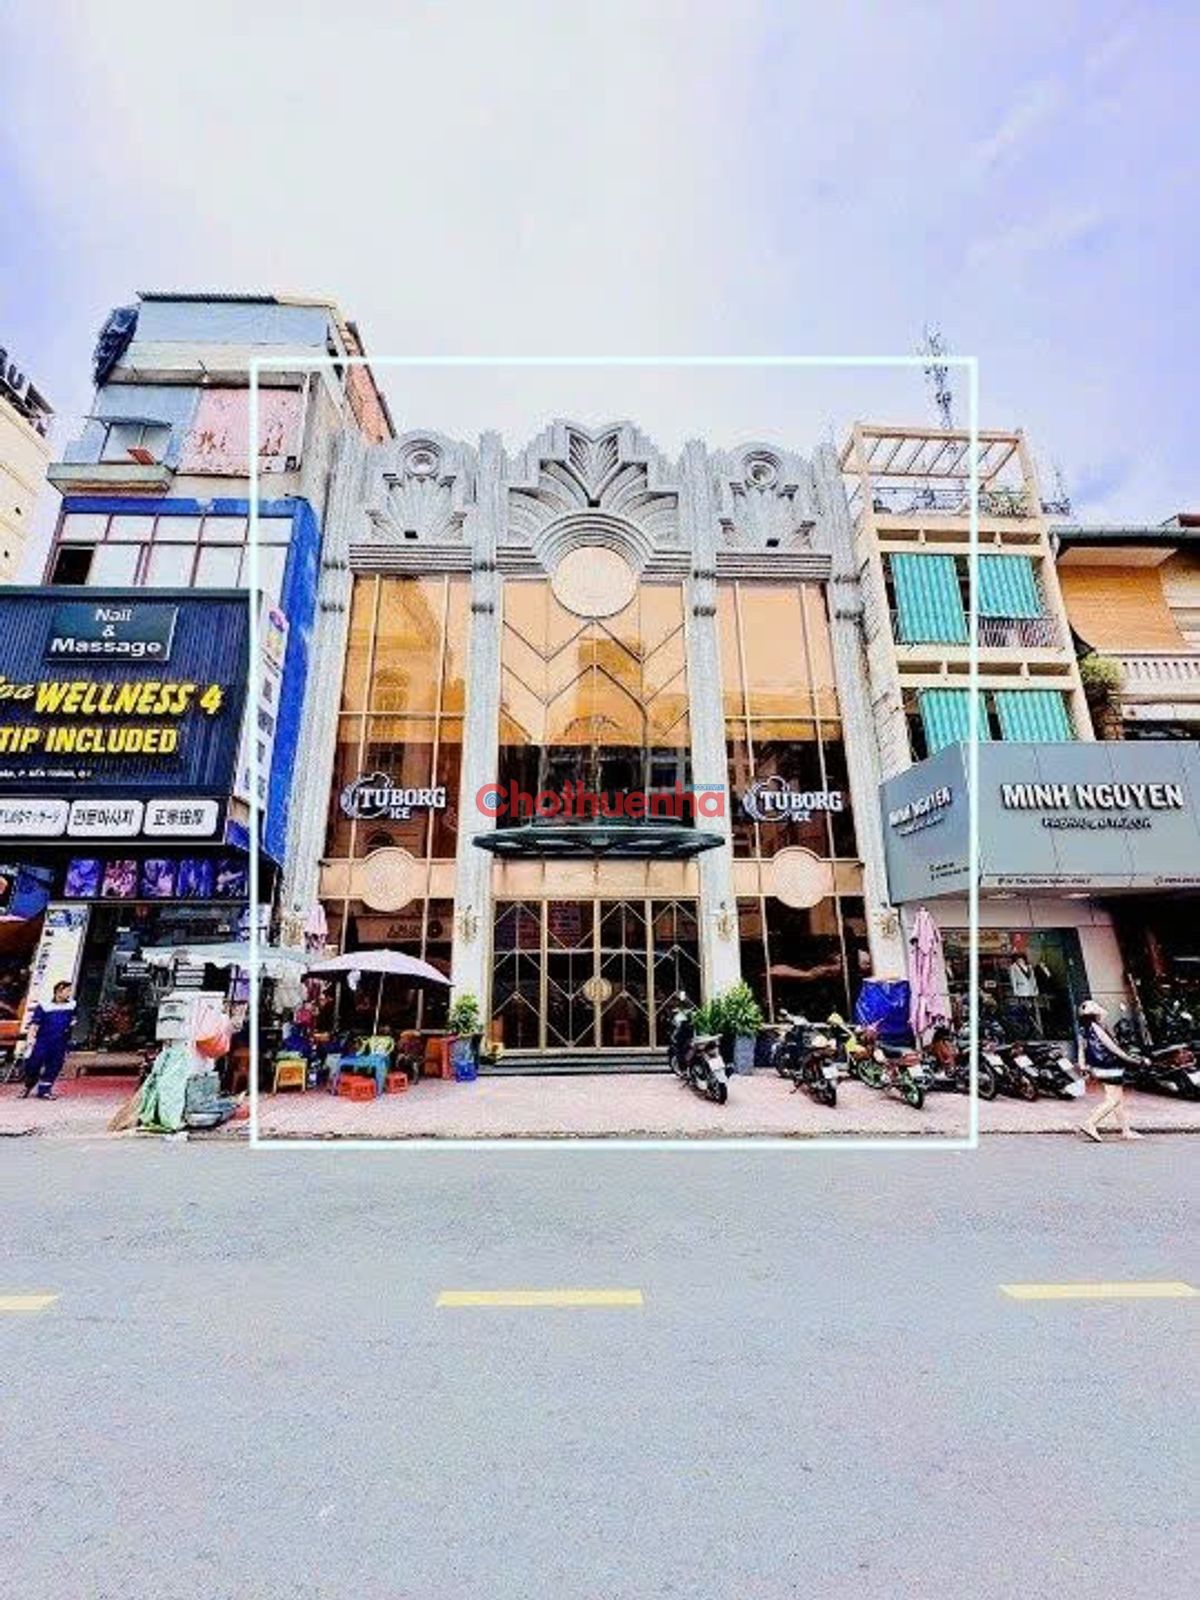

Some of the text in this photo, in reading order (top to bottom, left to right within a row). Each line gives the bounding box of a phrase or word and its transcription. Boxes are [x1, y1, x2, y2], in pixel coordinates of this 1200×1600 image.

[95, 608, 132, 621] Nail
[102, 624, 115, 637] &
[51, 638, 161, 656] Massage
[35, 682, 195, 714] WELLNESS
[200, 684, 224, 715] 4
[0, 727, 178, 753] TIP INCLUDED
[360, 787, 446, 808] TUBORG
[760, 791, 844, 812] TUBORG
[1001, 783, 1184, 809] MINH NGUYEN
[389, 807, 411, 819] ICE
